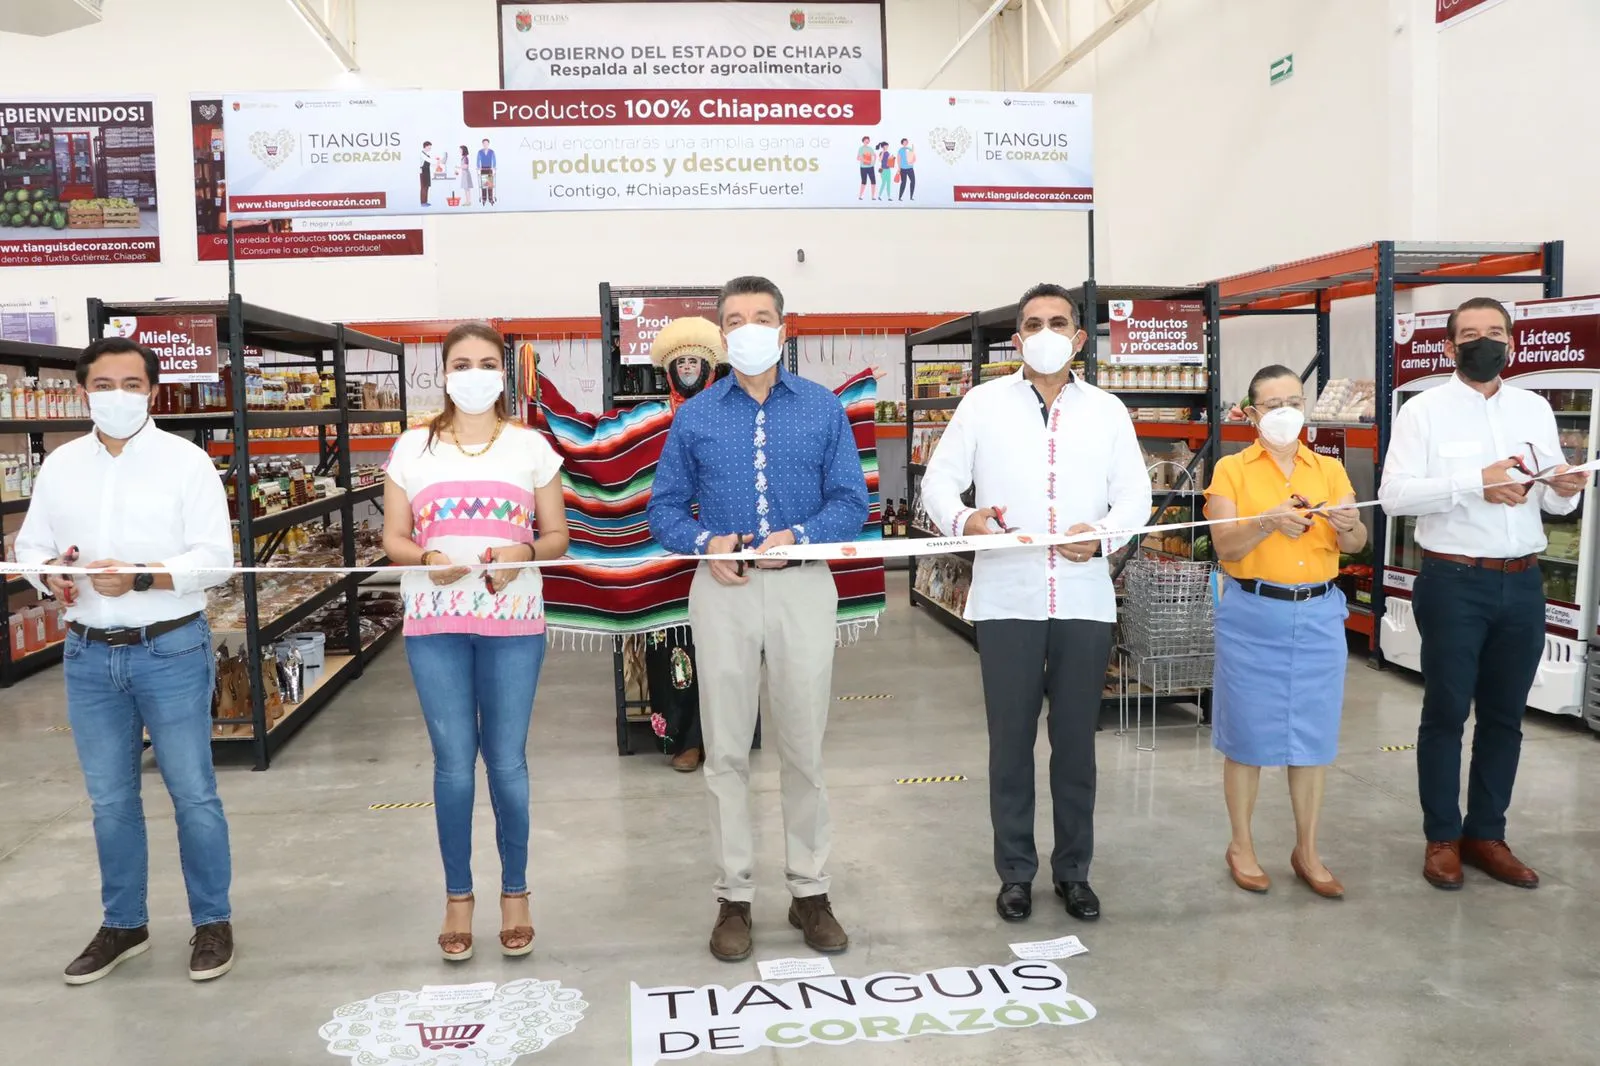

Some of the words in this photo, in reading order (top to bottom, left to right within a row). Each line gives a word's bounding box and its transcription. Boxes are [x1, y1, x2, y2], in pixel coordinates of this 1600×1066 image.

[534, 14, 569, 22] CHIAPAS
[526, 47, 625, 61] GOBIERNO
[631, 46, 667, 59] DEL
[672, 46, 747, 59] ESTADO
[753, 45, 777, 58] DE
[783, 45, 863, 59] CHIAPAS
[550, 62, 628, 78] Respalda
[633, 62, 647, 75] al
[653, 63, 705, 76] sector
[710, 61, 843, 76] agroalimentario
[0, 106, 145, 127] ¡BIENVENIDOS!
[492, 99, 617, 121] Productos
[623, 98, 691, 119] 100%
[698, 98, 855, 122] Chiapanecos
[308, 132, 401, 149] TIANGUIS
[519, 137, 559, 152] Aquí
[562, 136, 660, 150] encontrarás
[665, 139, 696, 149] una
[700, 135, 755, 151] amplia
[759, 138, 805, 151] gama
[809, 135, 831, 149] de
[983, 131, 1069, 148] TIANGUIS
[310, 153, 329, 164] DE
[332, 149, 401, 164] CORAZÓN
[985, 150, 1002, 161] DE
[1006, 149, 1069, 162] CORAZÓN
[531, 153, 657, 179] productos
[663, 157, 677, 178] y
[682, 152, 820, 173] descuentos
[548, 183, 621, 199] ¡Contigo,
[625, 182, 804, 198] #ChiapasEsMásFuerte!
[961, 190, 1093, 202] www.tianguisdecorazón.com
[236, 198, 381, 210] www.tianguisdecorazón.com
[213, 237, 228, 245] Gra
[234, 235, 271, 244] variedad
[272, 235, 283, 243] de
[284, 234, 326, 245] productos
[328, 234, 351, 242] 100%
[353, 232, 406, 242] Chiapanecos
[0, 241, 155, 254] ww.tianguisdecorazon.com
[241, 247, 281, 255] ¡Consume
[310, 245, 343, 254] Chiapas
[345, 244, 381, 253] produce!
[1, 255, 29, 263] dentro
[31, 254, 42, 262] de
[45, 254, 70, 262] Tuxtla
[71, 252, 112, 262] Gutiérrez,
[114, 252, 146, 262] Chiapas
[1127, 317, 1188, 329] Productos
[139, 331, 192, 346] Mieles,
[1128, 328, 1188, 342] orgánicos
[1520, 329, 1571, 346] Lácteos
[1121, 342, 1127, 353] y
[1130, 340, 1199, 354] procesados
[160, 356, 198, 370] ulces
[1508, 351, 1516, 367] y
[1518, 345, 1585, 364] derivados
[1401, 357, 1431, 369] carnes
[1432, 358, 1437, 371] y
[1314, 444, 1331, 454] Frutos
[1332, 444, 1339, 454] de
[647, 964, 1063, 1019] TIANGUIS
[659, 1026, 745, 1055] DE
[764, 999, 1090, 1044] CORAZÓN
